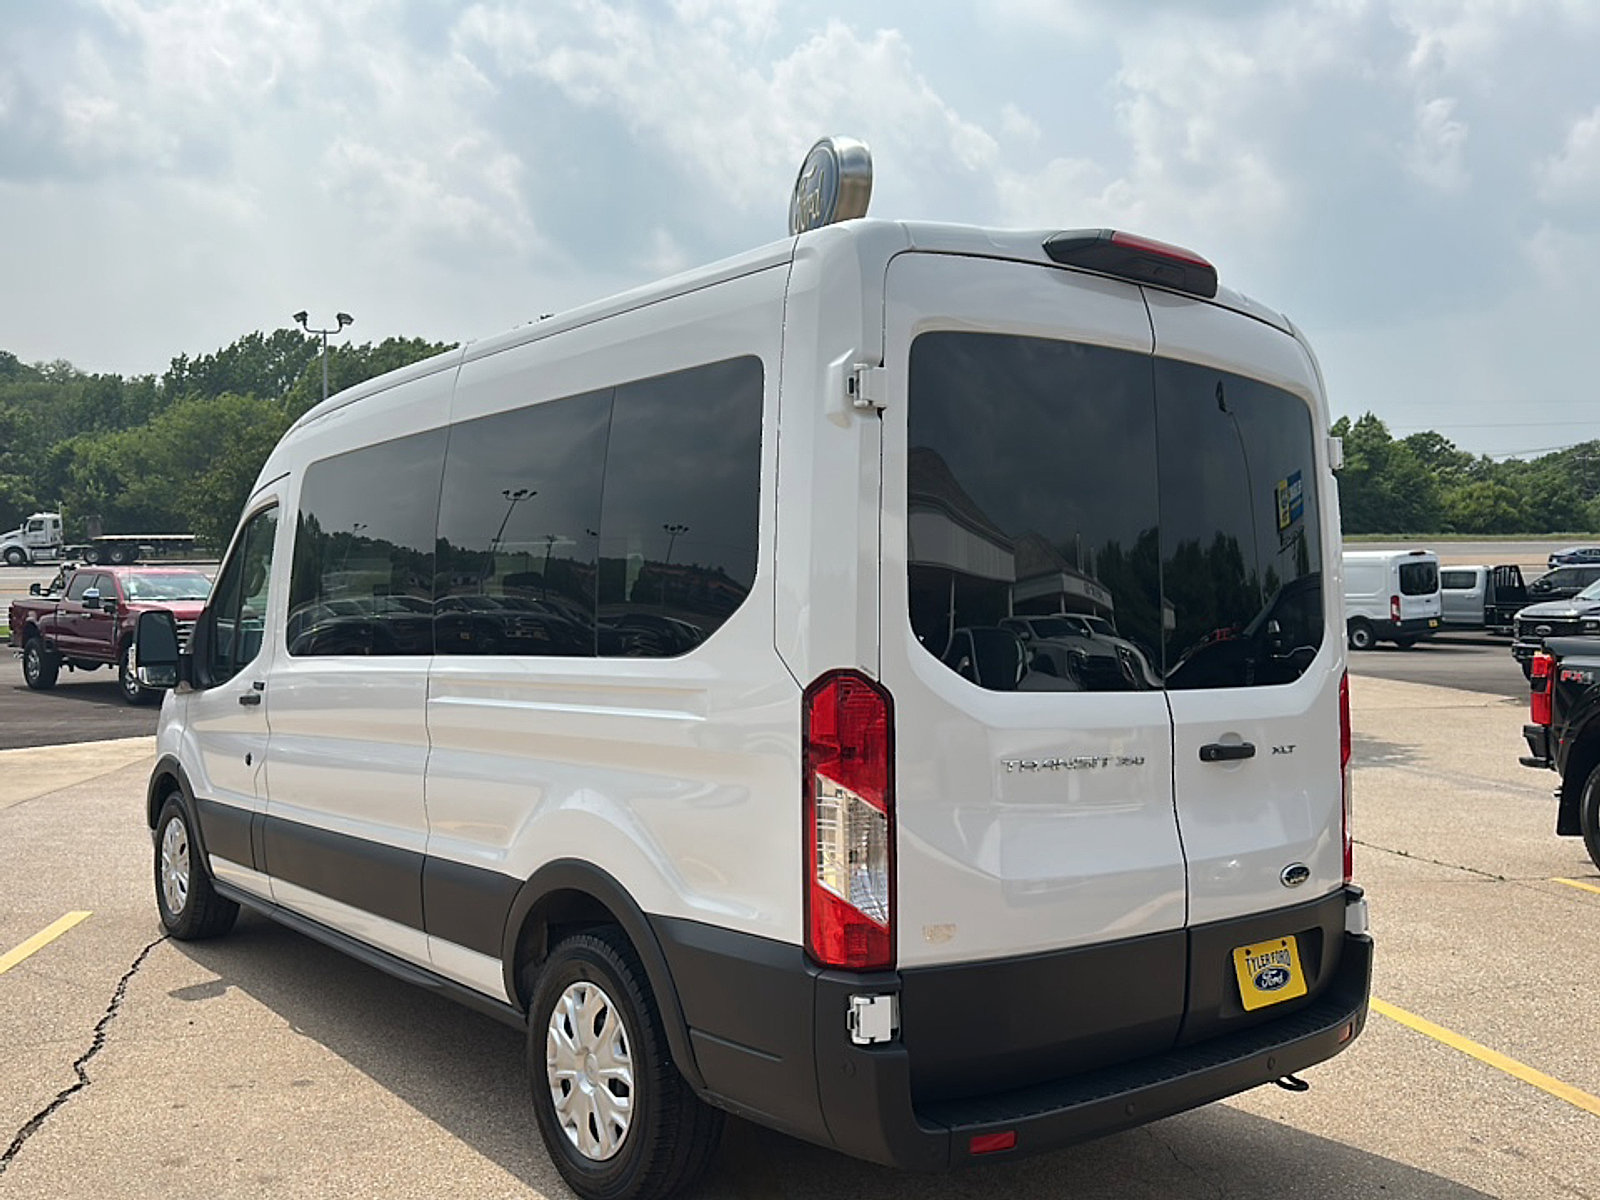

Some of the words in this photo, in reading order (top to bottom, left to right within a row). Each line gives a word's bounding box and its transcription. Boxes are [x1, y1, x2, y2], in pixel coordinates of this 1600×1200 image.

[1271, 744, 1297, 756] XLT
[1244, 953, 1271, 978] TYLER
[1270, 948, 1291, 967] FORD
[1261, 969, 1284, 988] Ford
